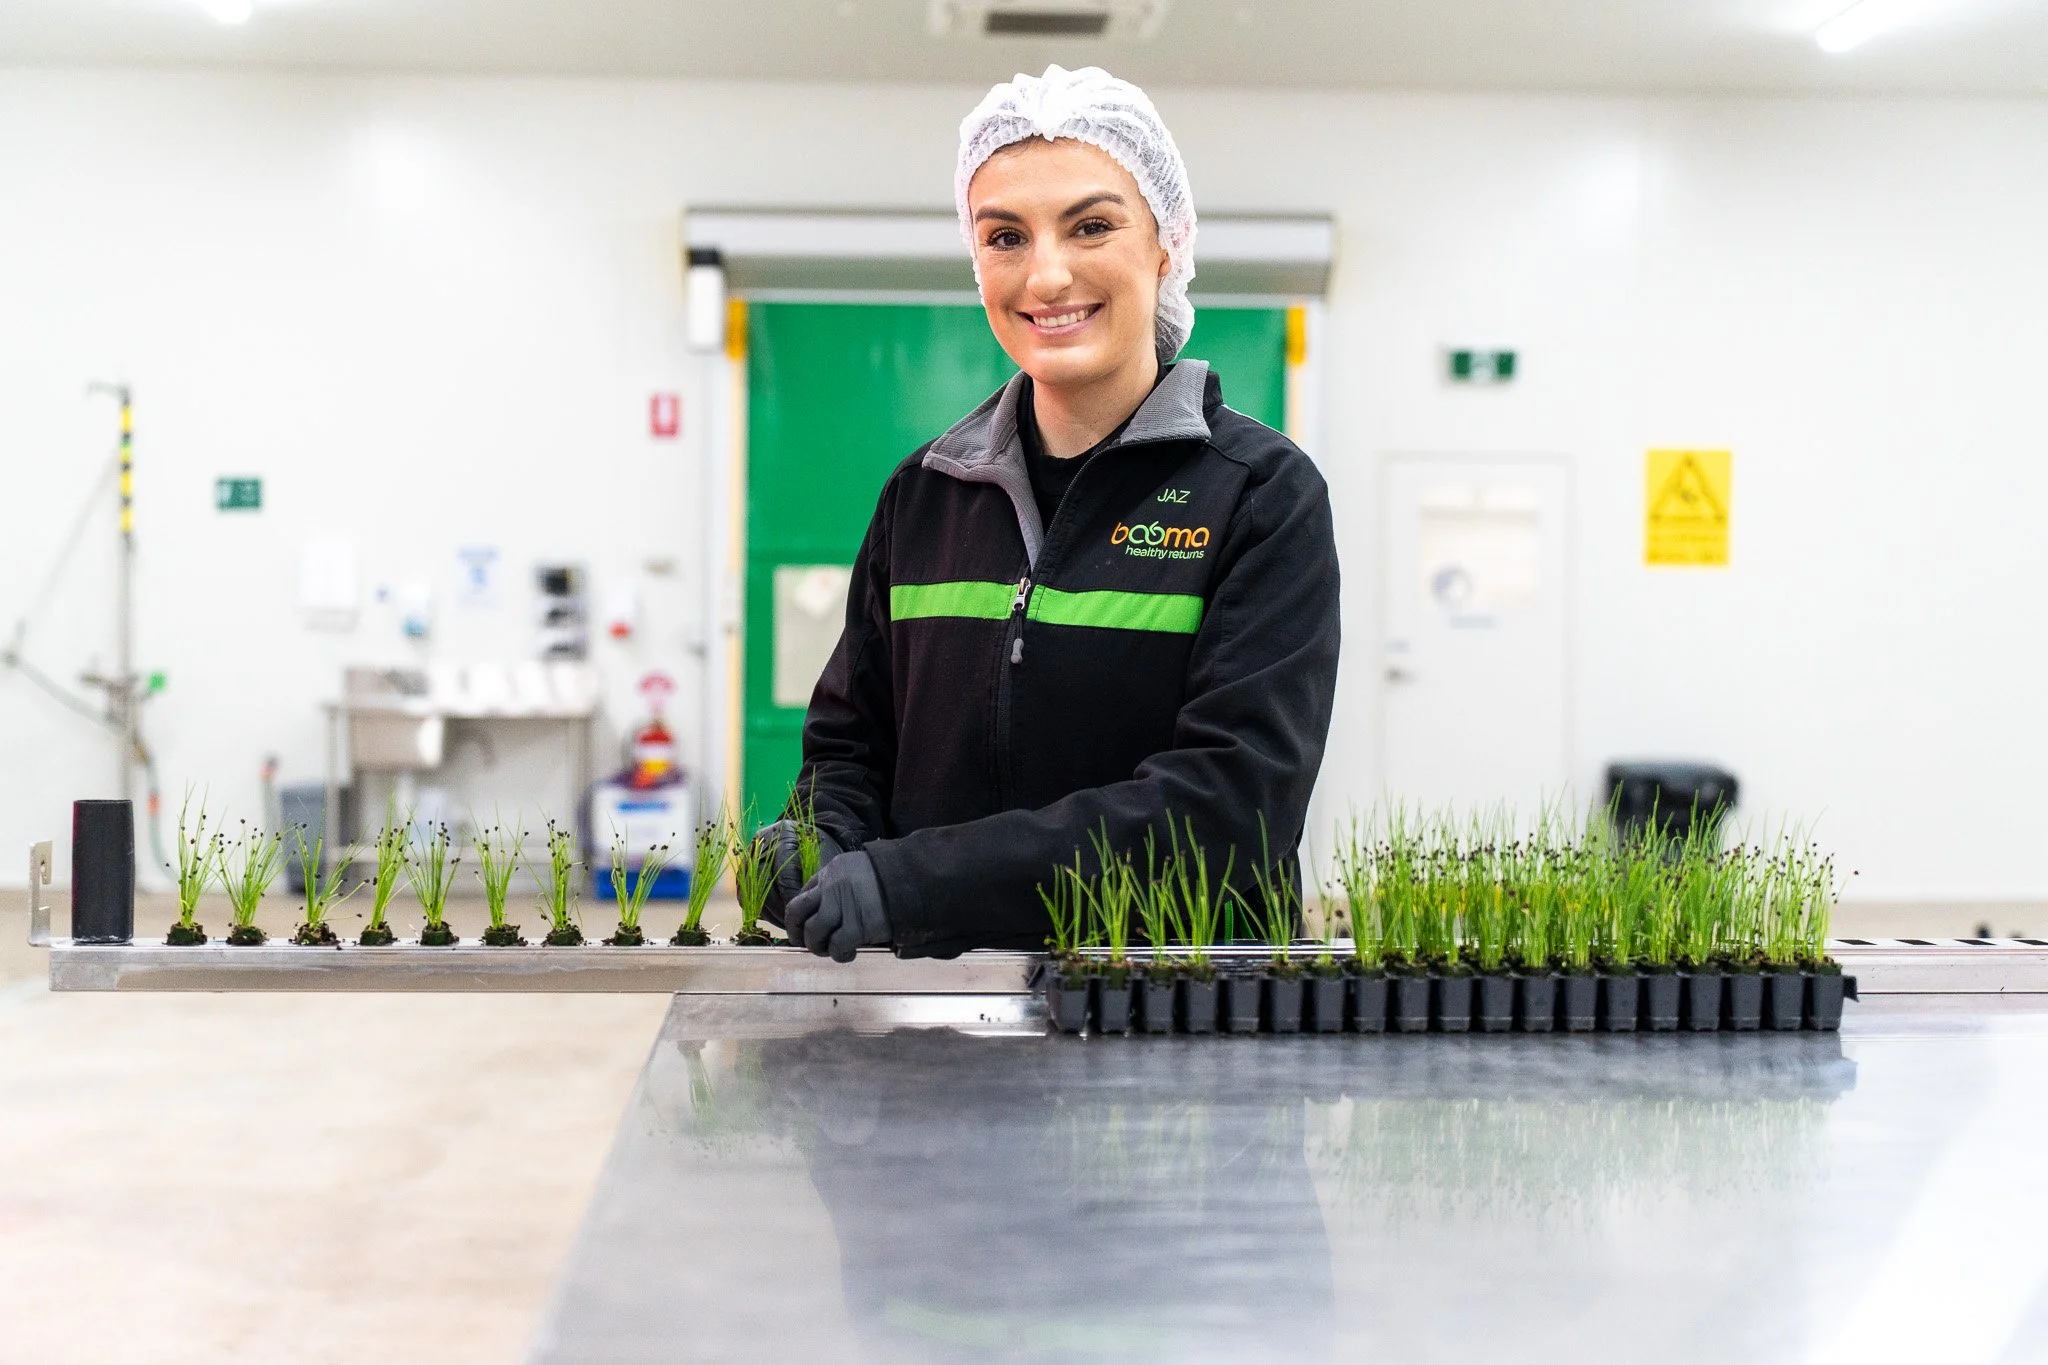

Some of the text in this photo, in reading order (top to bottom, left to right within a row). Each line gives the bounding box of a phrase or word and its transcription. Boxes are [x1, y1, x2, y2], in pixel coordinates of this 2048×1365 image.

[1157, 488, 1191, 504] JAZ
[1110, 521, 1210, 549] booma
[1125, 545, 1205, 559] healthy returns
